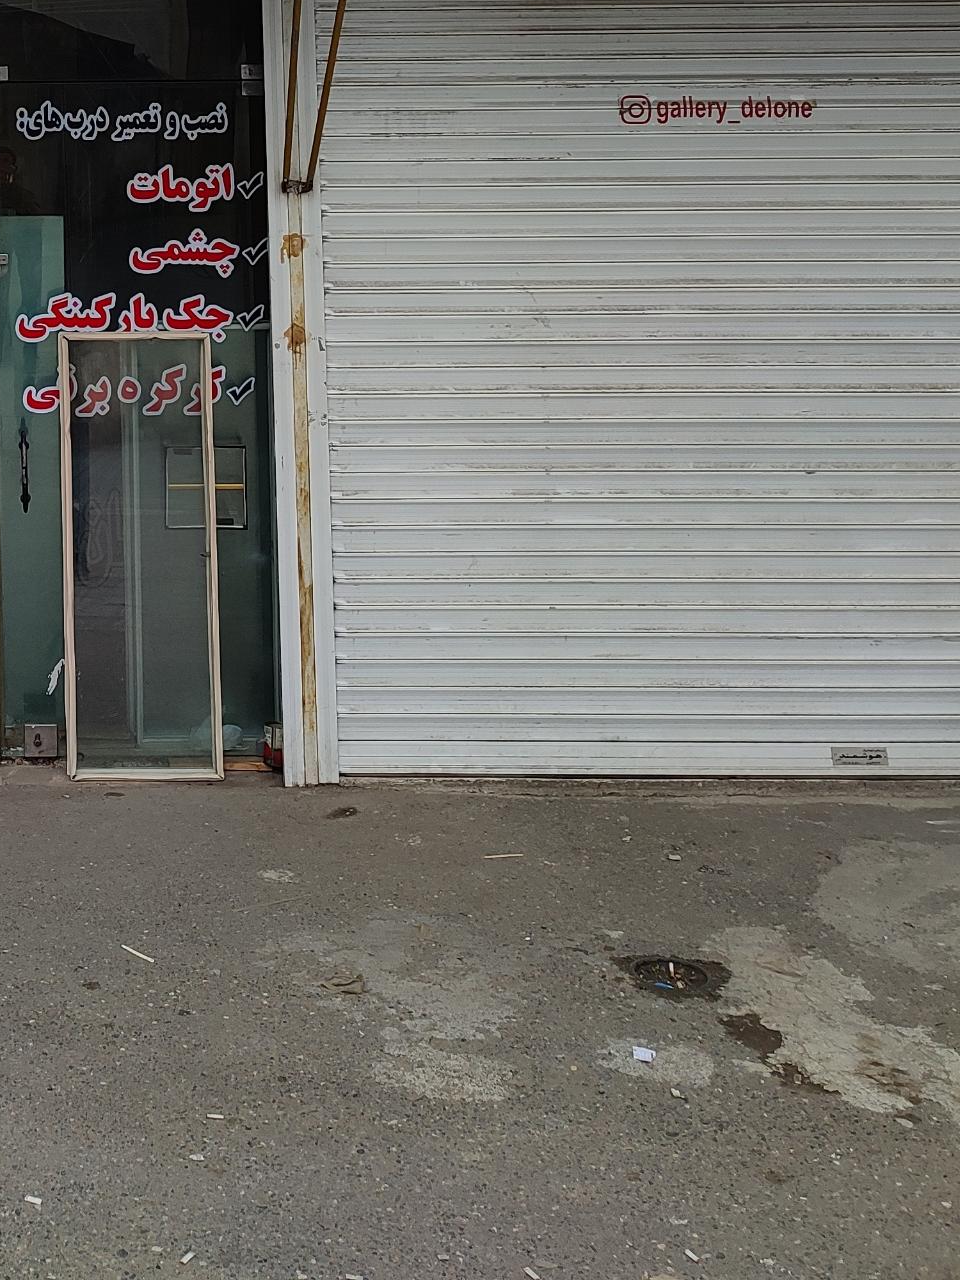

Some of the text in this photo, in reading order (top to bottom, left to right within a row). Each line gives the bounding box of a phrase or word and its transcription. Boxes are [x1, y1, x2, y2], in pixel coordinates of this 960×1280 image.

[111, 103, 162, 141] تعمیر
[164, 111, 181, 140] و
[181, 101, 229, 140] نصب
[656, 95, 814, 124] gallery_delone
[127, 162, 235, 212] اتومات
[129, 227, 240, 278] چشمی
[162, 293, 235, 344] جک
